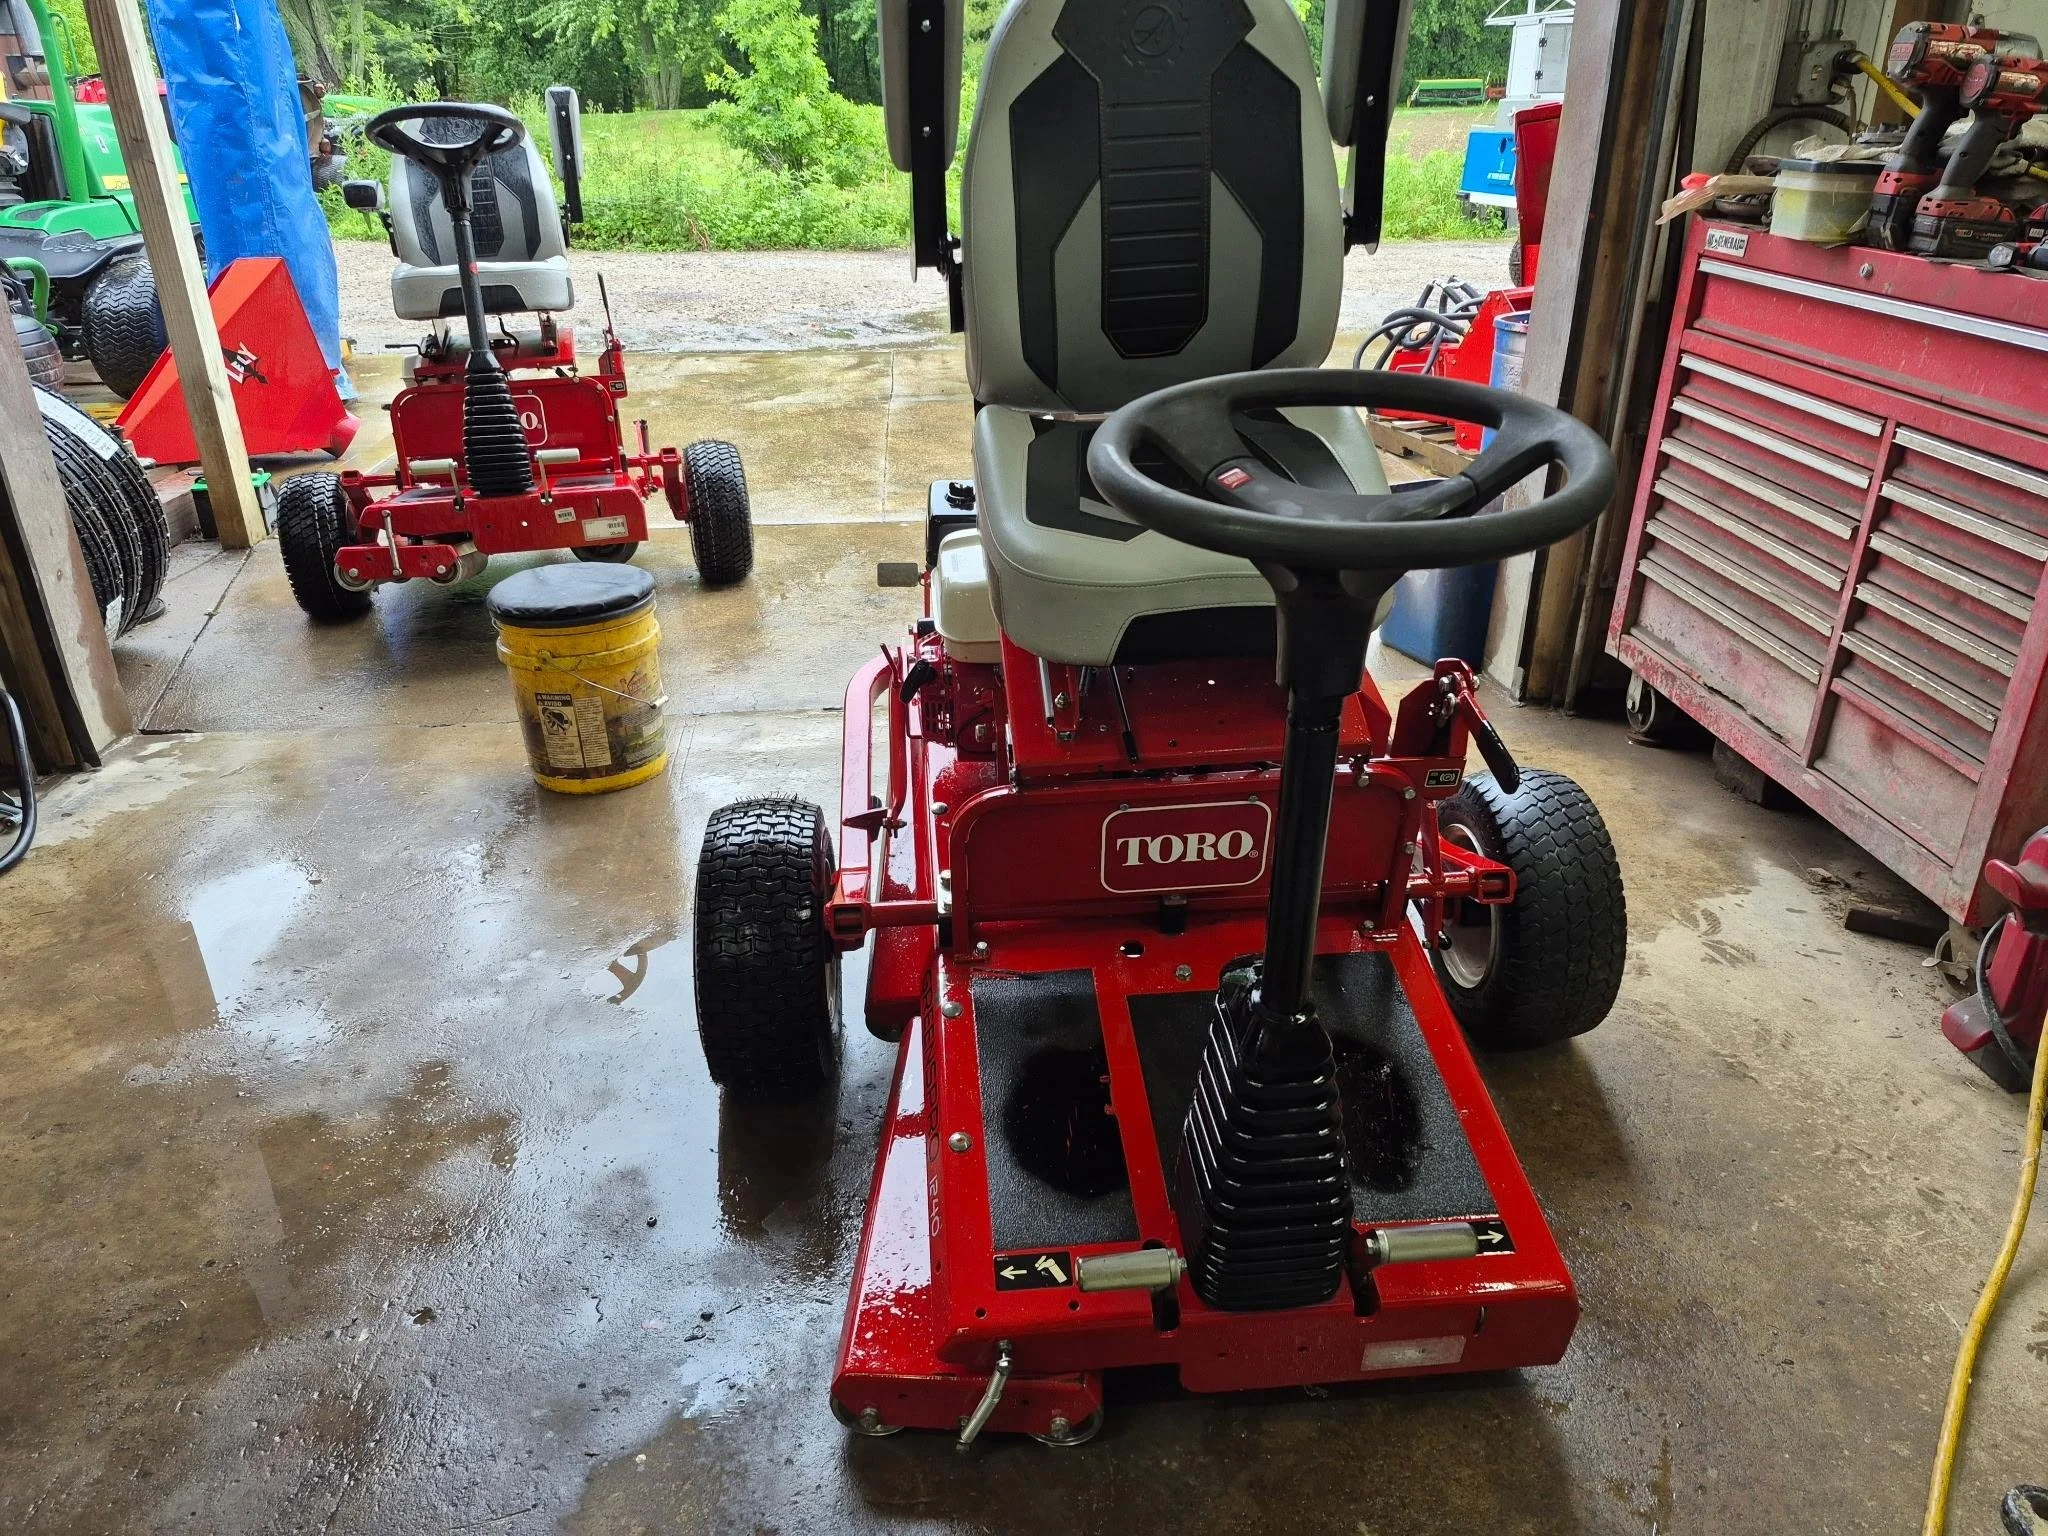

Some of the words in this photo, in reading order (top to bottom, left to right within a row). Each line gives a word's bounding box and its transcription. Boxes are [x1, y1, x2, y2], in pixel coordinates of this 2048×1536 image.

[1717, 234, 1741, 251] GENERAL
[225, 341, 258, 384] LELY
[1116, 829, 1254, 867] TORO
[920, 969, 942, 1163] GREENSPRO
[929, 1174, 942, 1237] 1240
